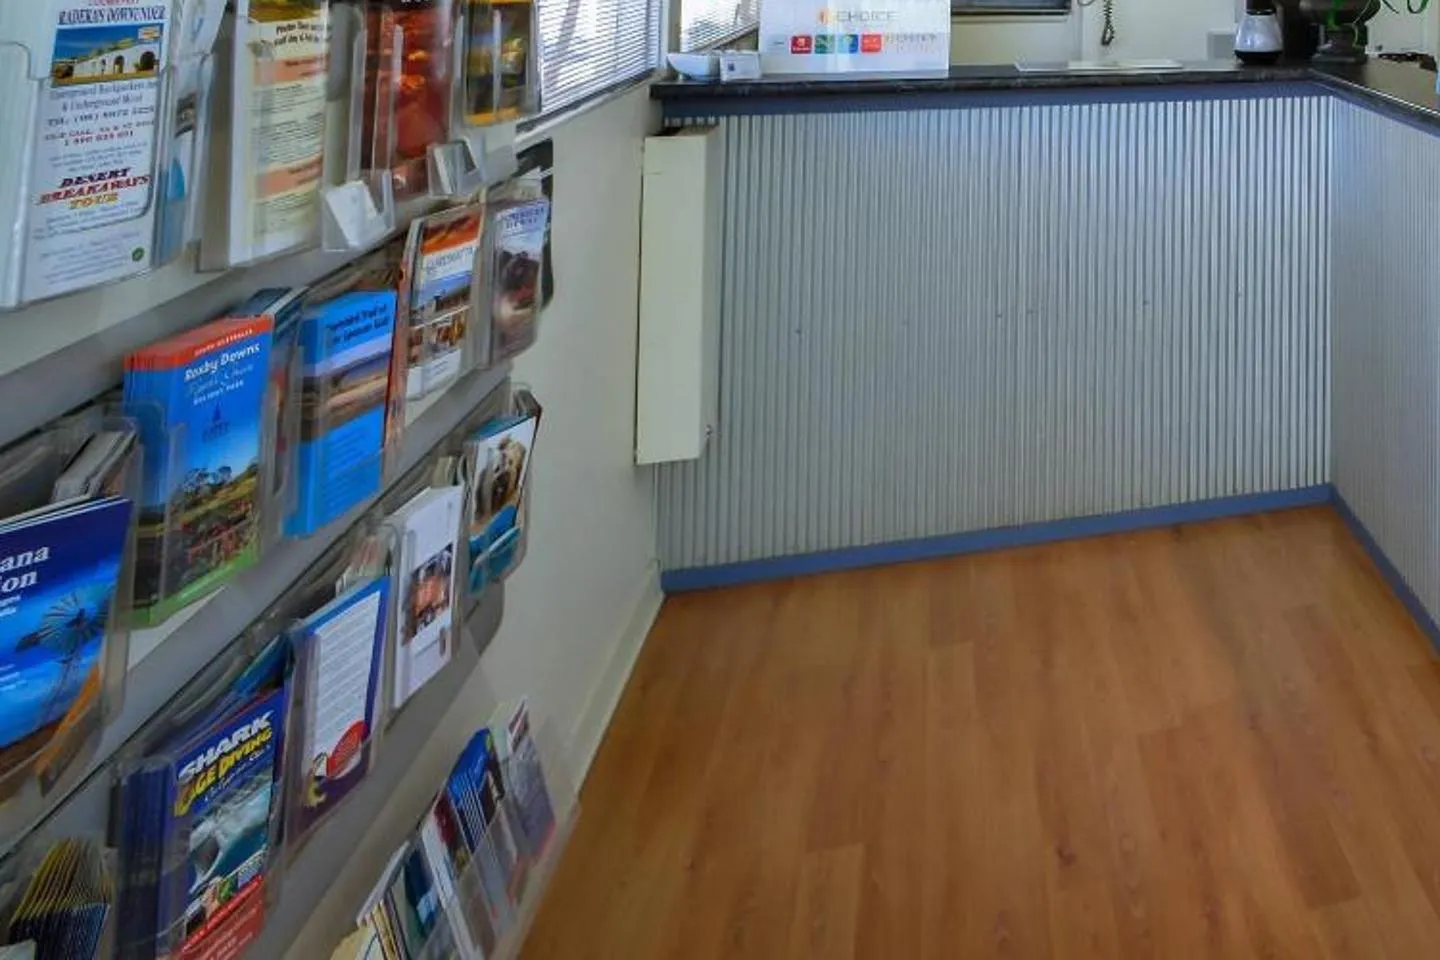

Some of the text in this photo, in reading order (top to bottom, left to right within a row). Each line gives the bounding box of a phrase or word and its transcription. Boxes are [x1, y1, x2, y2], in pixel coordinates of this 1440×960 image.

[59, 166, 132, 188] DESERT
[220, 343, 260, 366] Downs
[0, 546, 50, 573] ana
[0, 570, 38, 593] on
[177, 709, 275, 781] SHARK
